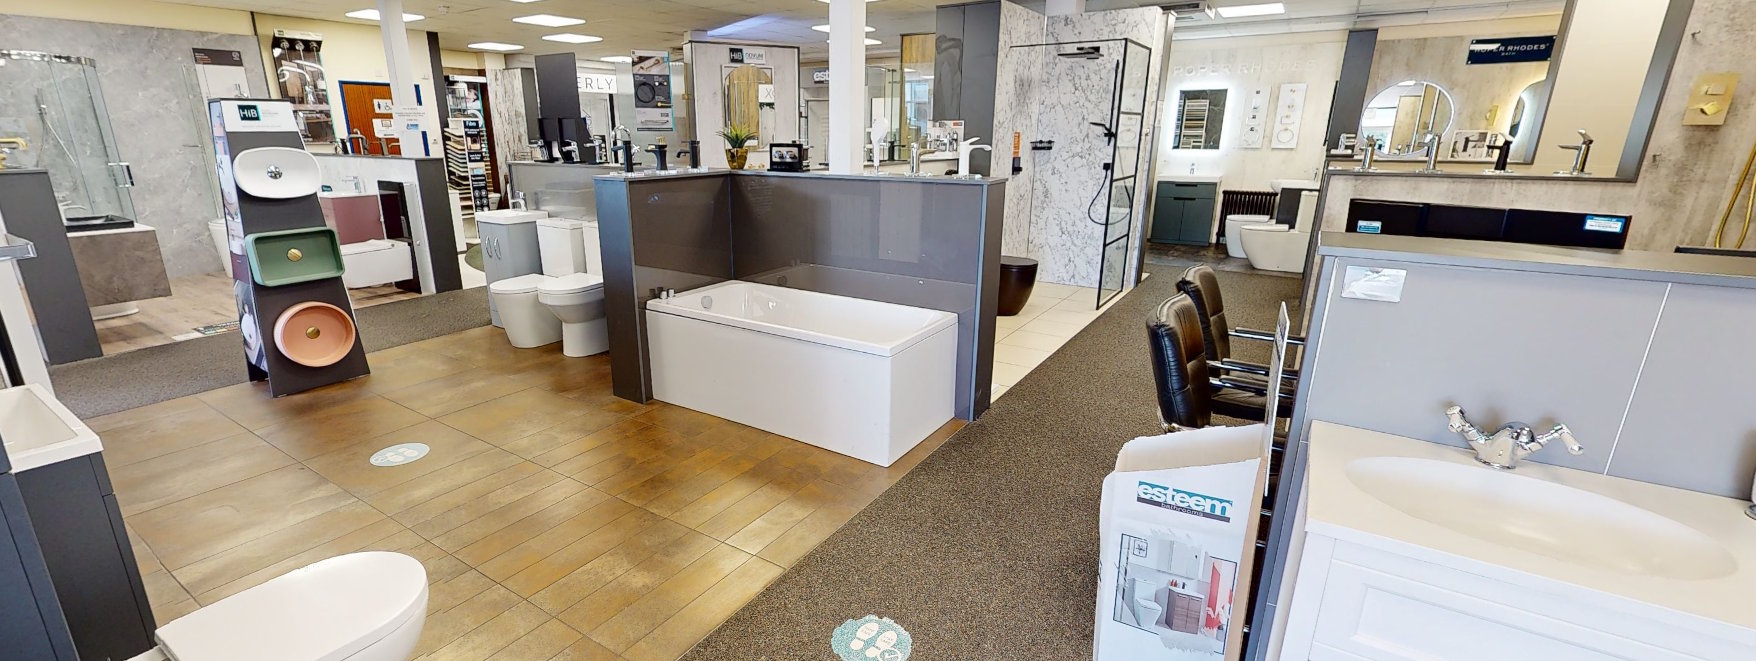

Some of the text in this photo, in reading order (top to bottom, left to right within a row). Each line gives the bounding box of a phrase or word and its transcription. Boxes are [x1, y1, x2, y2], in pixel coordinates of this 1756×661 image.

[239, 108, 258, 118] HiB
[1137, 483, 1233, 517] esteem
[1161, 502, 1204, 518] bathrooms
